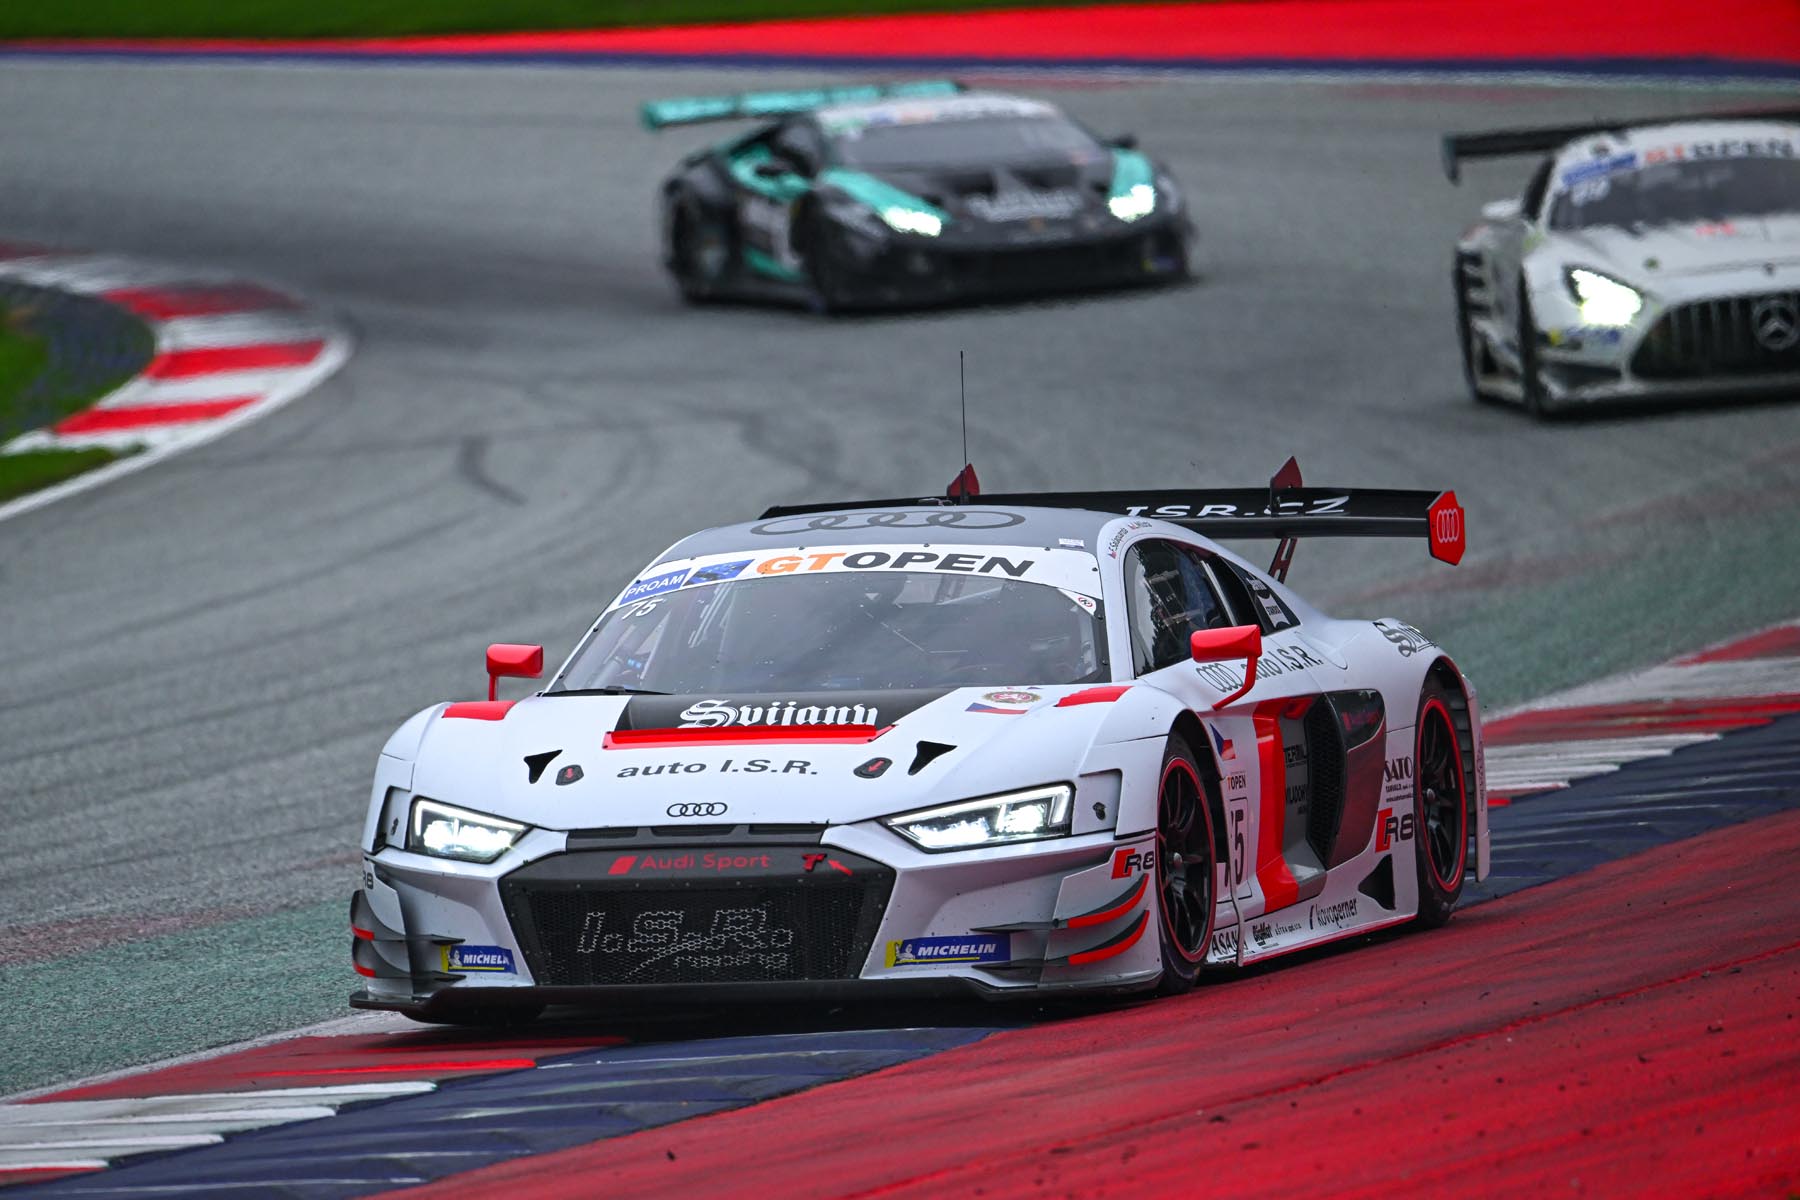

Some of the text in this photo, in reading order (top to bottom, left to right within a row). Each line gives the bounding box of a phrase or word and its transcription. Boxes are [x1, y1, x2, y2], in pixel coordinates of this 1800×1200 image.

[1126, 495, 1351, 518] ISR.CZ
[627, 573, 683, 598] PROAM
[621, 599, 664, 619] 75
[1274, 645, 1324, 672] I.S.R.
[679, 700, 879, 728] Svijany
[616, 758, 819, 779] auto I.S.R.
[1384, 756, 1413, 782] SATO
[1384, 813, 1414, 845] R8
[641, 852, 771, 871] Audi Sport
[1124, 850, 1155, 873] R8
[917, 942, 997, 958] MICHELIN
